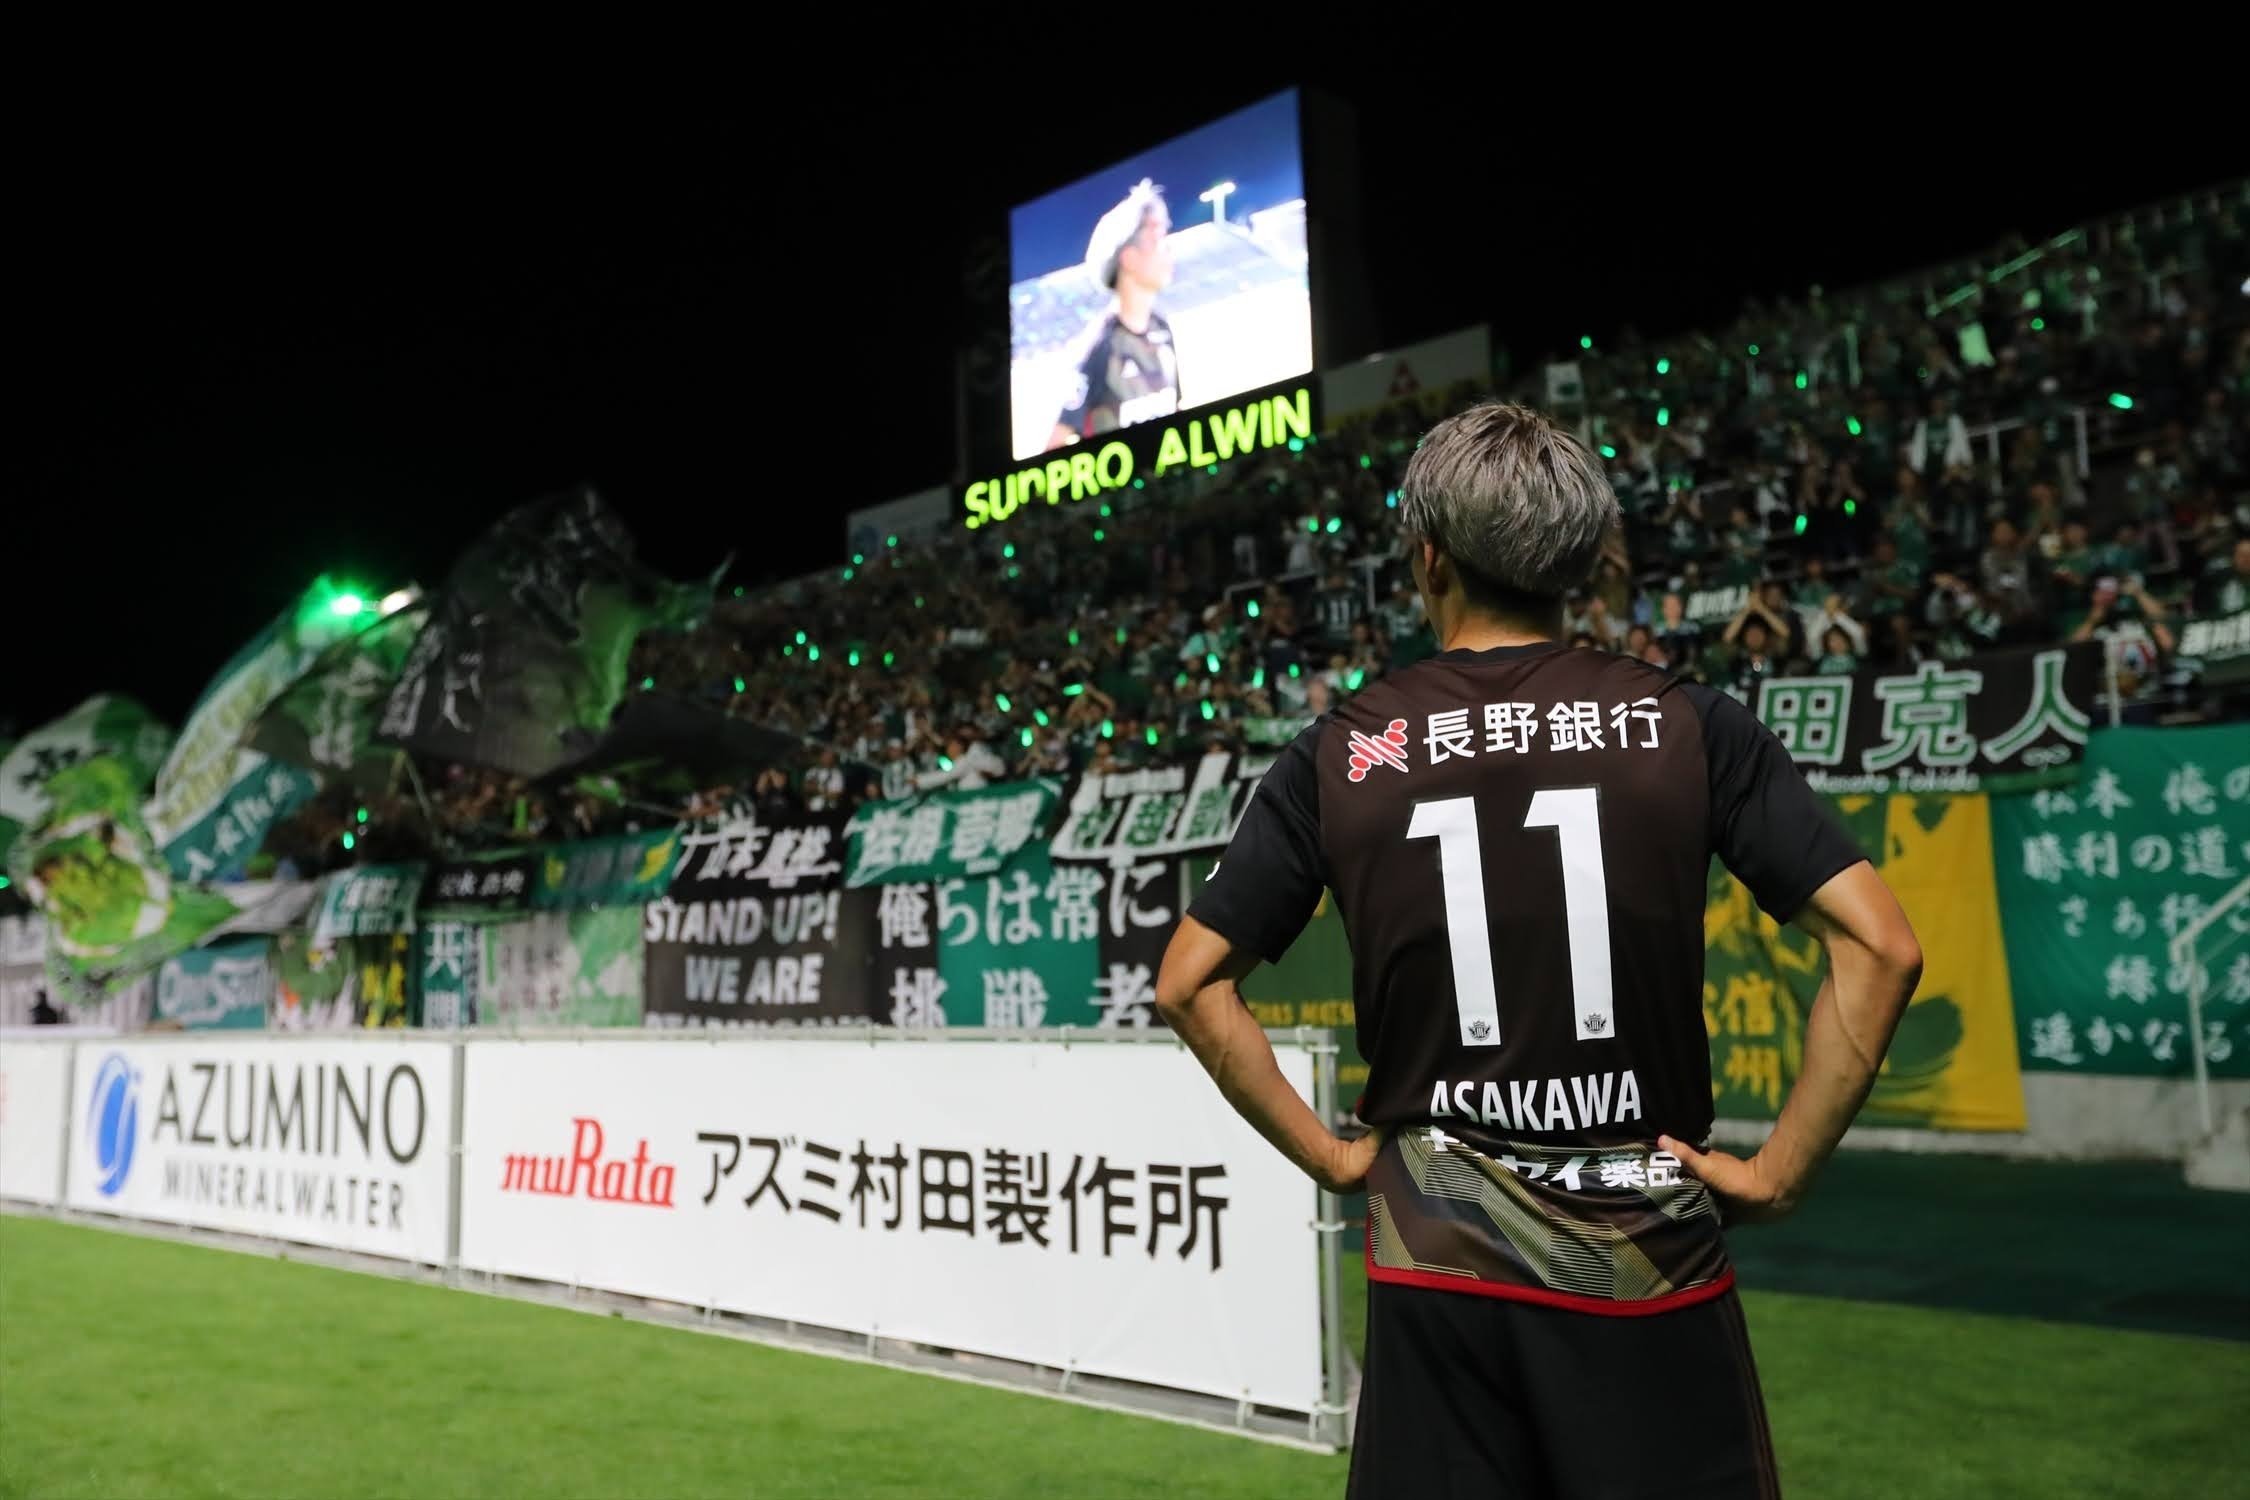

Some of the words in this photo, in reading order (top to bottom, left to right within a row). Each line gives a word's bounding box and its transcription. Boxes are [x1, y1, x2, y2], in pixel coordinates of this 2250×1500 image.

[1155, 388, 1311, 478] ALWIN
[1422, 698, 1663, 765] 長野銀行
[1724, 650, 2091, 772] 田克人
[2022, 825, 2250, 884] 勝利の道
[645, 896, 764, 945] STAND
[772, 890, 841, 944] UP!
[878, 858, 1171, 948] 俺らは常に
[1405, 786, 1616, 1047] 11
[685, 954, 742, 1004] WE
[745, 953, 825, 1005] ARE
[889, 963, 1155, 1028] 挑戦者
[152, 1061, 427, 1165] AZUMINO
[1430, 1069, 1642, 1131] ASAKAWA
[697, 1130, 1230, 1271] アズミ村田製作所
